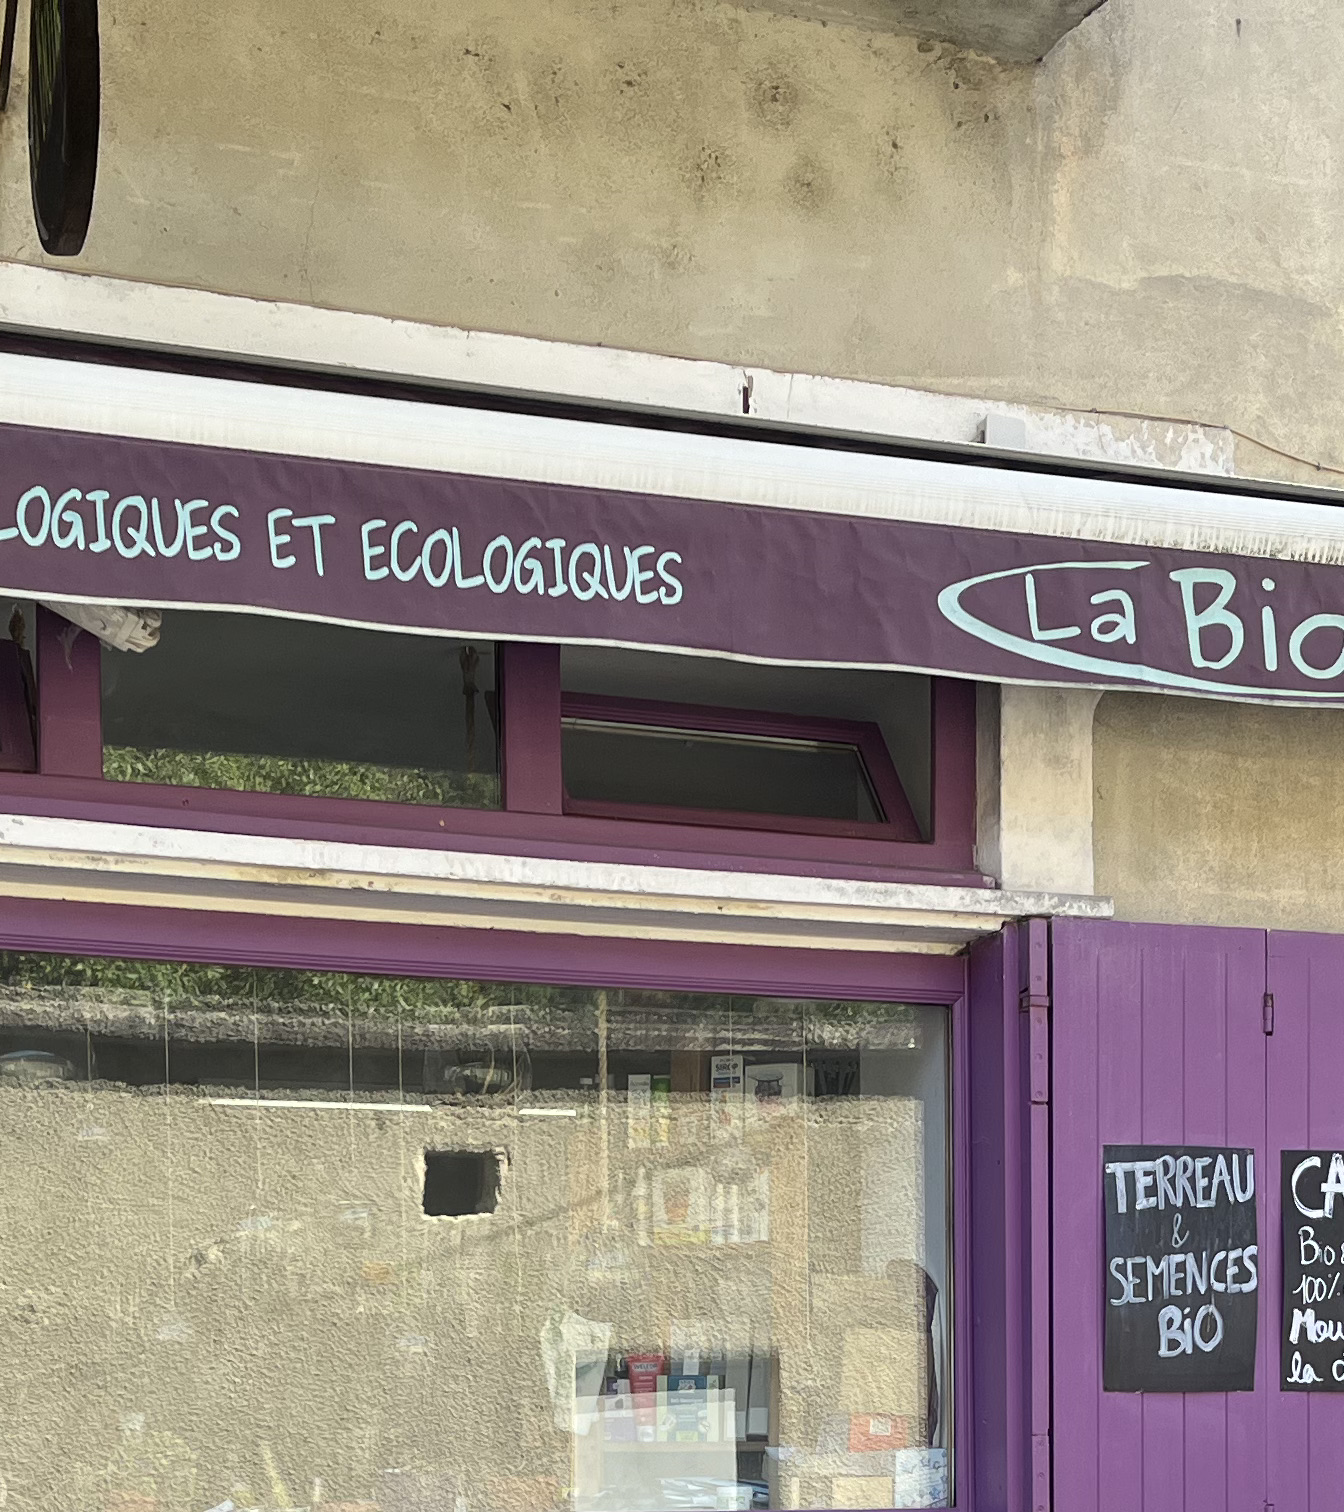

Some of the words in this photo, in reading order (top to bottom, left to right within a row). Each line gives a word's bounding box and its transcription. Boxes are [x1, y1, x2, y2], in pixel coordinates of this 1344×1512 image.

[265, 507, 337, 577] ET
[360, 518, 684, 606] ECOLOGIQUES
[1024, 573, 1136, 646] La
[1105, 1152, 1255, 1214] TERREAU
[1171, 1212, 1190, 1249] &
[1109, 1245, 1258, 1306] SEMENCES
[1286, 1351, 1324, 1384] la
